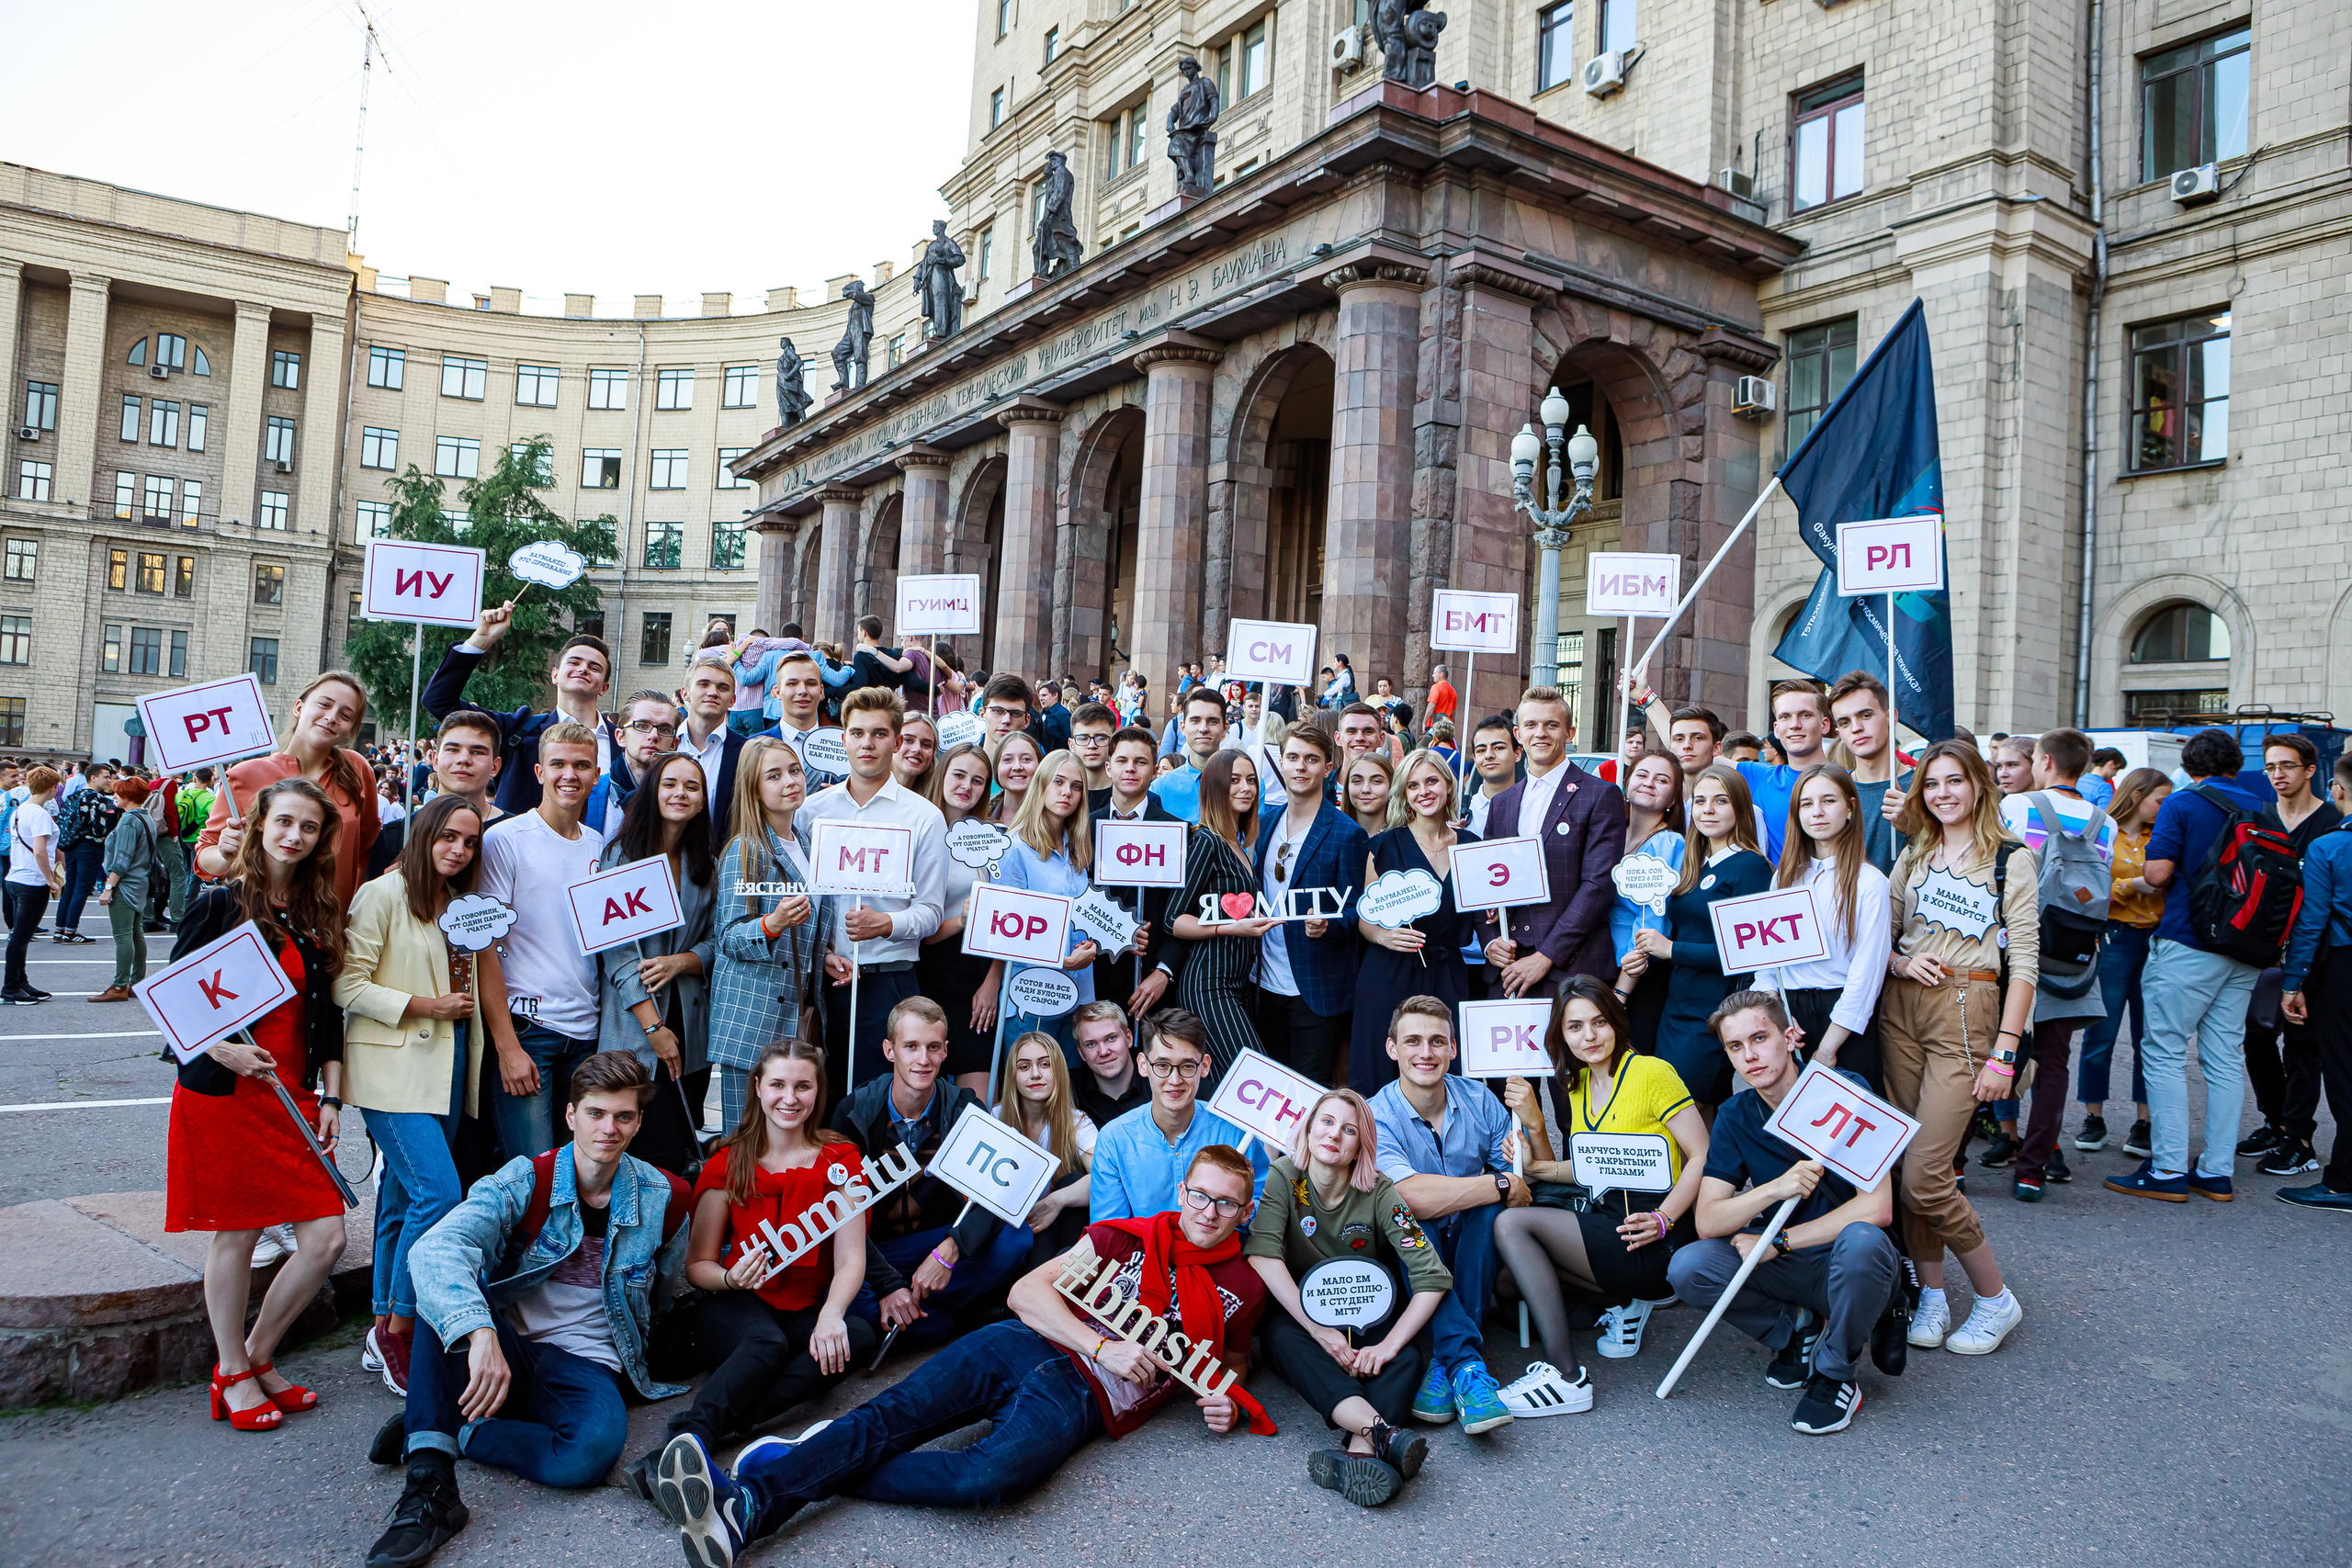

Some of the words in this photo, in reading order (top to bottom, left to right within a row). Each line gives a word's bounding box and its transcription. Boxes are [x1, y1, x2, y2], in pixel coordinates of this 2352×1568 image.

[811, 436, 863, 476] МОСКОВСКИЙ
[867, 395, 948, 450] ГОСУДАРСТВЕННЫЙ
[956, 367, 1027, 407] ТЕХНИЧЕСКИЙ
[1037, 310, 1127, 369] УНИВЕРСИТЕТ
[1212, 237, 1286, 290] БАУМАНА
[1867, 543, 1911, 571] РЛ
[396, 568, 454, 600] ИУ
[1600, 573, 1666, 598] ИБМ
[908, 599, 969, 613] ГУИМЦ
[1445, 610, 1506, 634] БМТ
[1249, 641, 1292, 665] СМ
[183, 705, 232, 743] РТ
[838, 846, 888, 874] МТ
[1115, 842, 1165, 867] ФН
[1487, 863, 1510, 887] Э
[603, 886, 654, 926] АК
[1255, 886, 1353, 919] МГТУ
[1368, 903, 1384, 915] ЭТО
[1385, 888, 1432, 909] ПРИЗВАНИЕ
[1374, 887, 1418, 905] БАУМАНЕЦ
[1923, 894, 1929, 902] В
[1930, 897, 1988, 923] ХОГВАРТСЕ
[1936, 887, 1970, 908] МАМА,
[1972, 901, 1980, 909] Я
[461, 908, 500, 920] ГОВОРИЛИ,
[462, 919, 482, 927] ОДНИ
[483, 913, 508, 923] ПАРНИ
[989, 909, 1048, 941] ЮР
[1075, 905, 1082, 913] В
[1081, 910, 1126, 943] ХОГВАРТСЕ
[1088, 903, 1115, 926] МАМА,
[1115, 922, 1124, 931] Я
[466, 923, 492, 933] УЧАТСЯ
[1734, 913, 1803, 950] РКТ
[198, 967, 240, 1010] К
[1014, 986, 1036, 994] РАДИ
[1036, 989, 1073, 1001] БУЛОЧКИ
[1019, 977, 1044, 987] ГОТОВ
[1057, 985, 1071, 993] ВСЕ
[1031, 997, 1059, 1007] СЫРОМ
[1490, 1024, 1540, 1052] РК
[1237, 1079, 1307, 1129] СГН
[1810, 1101, 1877, 1148] ЛТ
[1577, 1145, 1622, 1156] НАУЧУСЬ
[1623, 1147, 1663, 1157] КОДИТЬ
[1595, 1156, 1657, 1167] ЗАКРЫТЫМИ
[967, 1140, 1021, 1188] ПС
[1599, 1167, 1645, 1177] ГЛАЗАМИ
[739, 1141, 922, 1282] #bmstu
[1317, 1287, 1348, 1296] МАЛО
[1350, 1284, 1382, 1293] СПЛЮ
[1322, 1276, 1353, 1285] МАЛО
[1355, 1274, 1371, 1282] ЕМ
[1329, 1295, 1375, 1305] СТУДЕНТ
[1334, 1306, 1362, 1316] МГТУ
[1052, 1247, 1238, 1400] #bmstu
